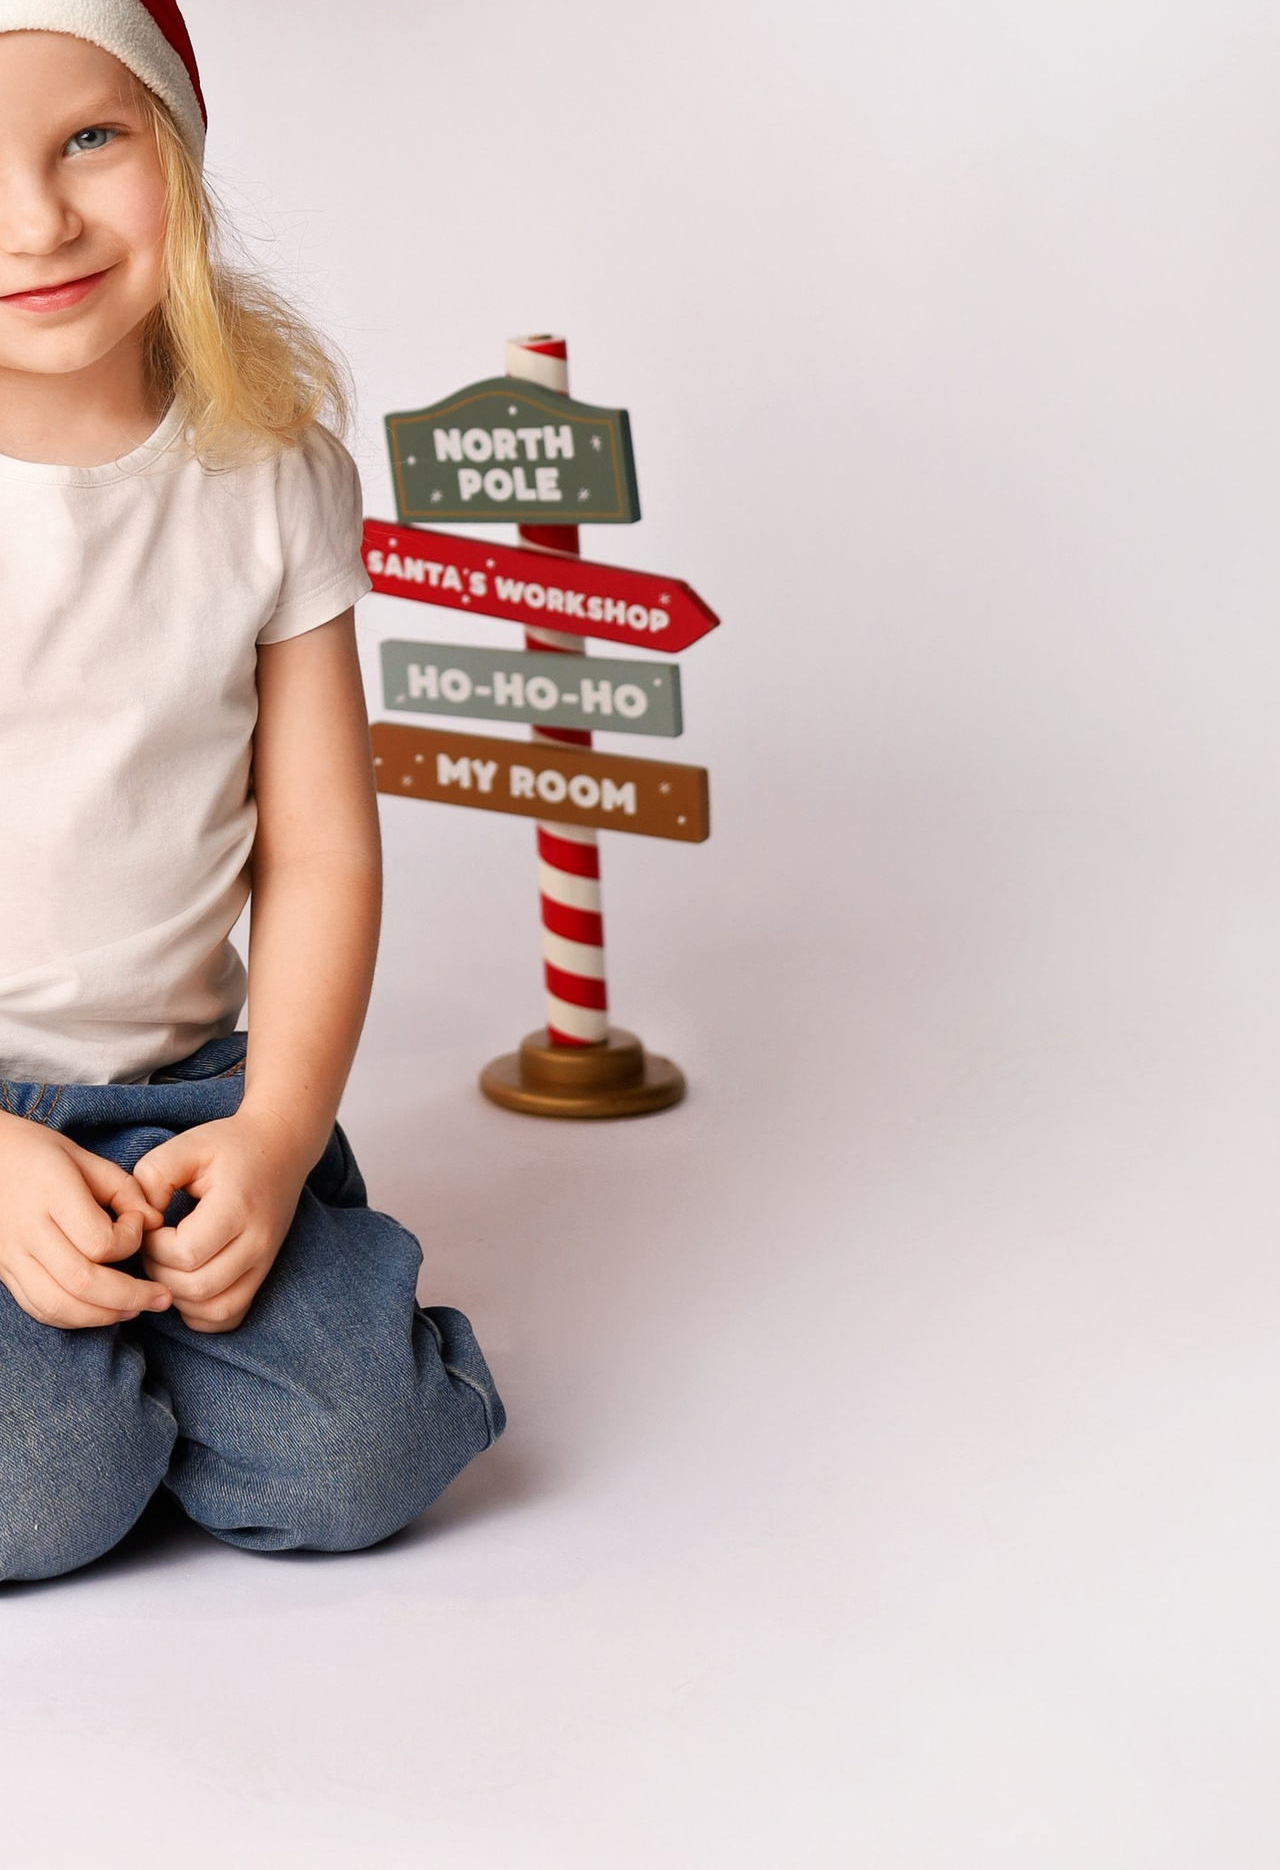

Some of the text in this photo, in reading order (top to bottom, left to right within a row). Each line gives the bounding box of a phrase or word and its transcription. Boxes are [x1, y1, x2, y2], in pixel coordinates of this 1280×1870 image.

[433, 426, 574, 462] NORTH
[458, 467, 562, 502] POLE
[367, 551, 669, 633] SANTA'S WORKSHOP
[407, 664, 647, 718] HO-HO-HO
[436, 753, 636, 814] MY ROOM
